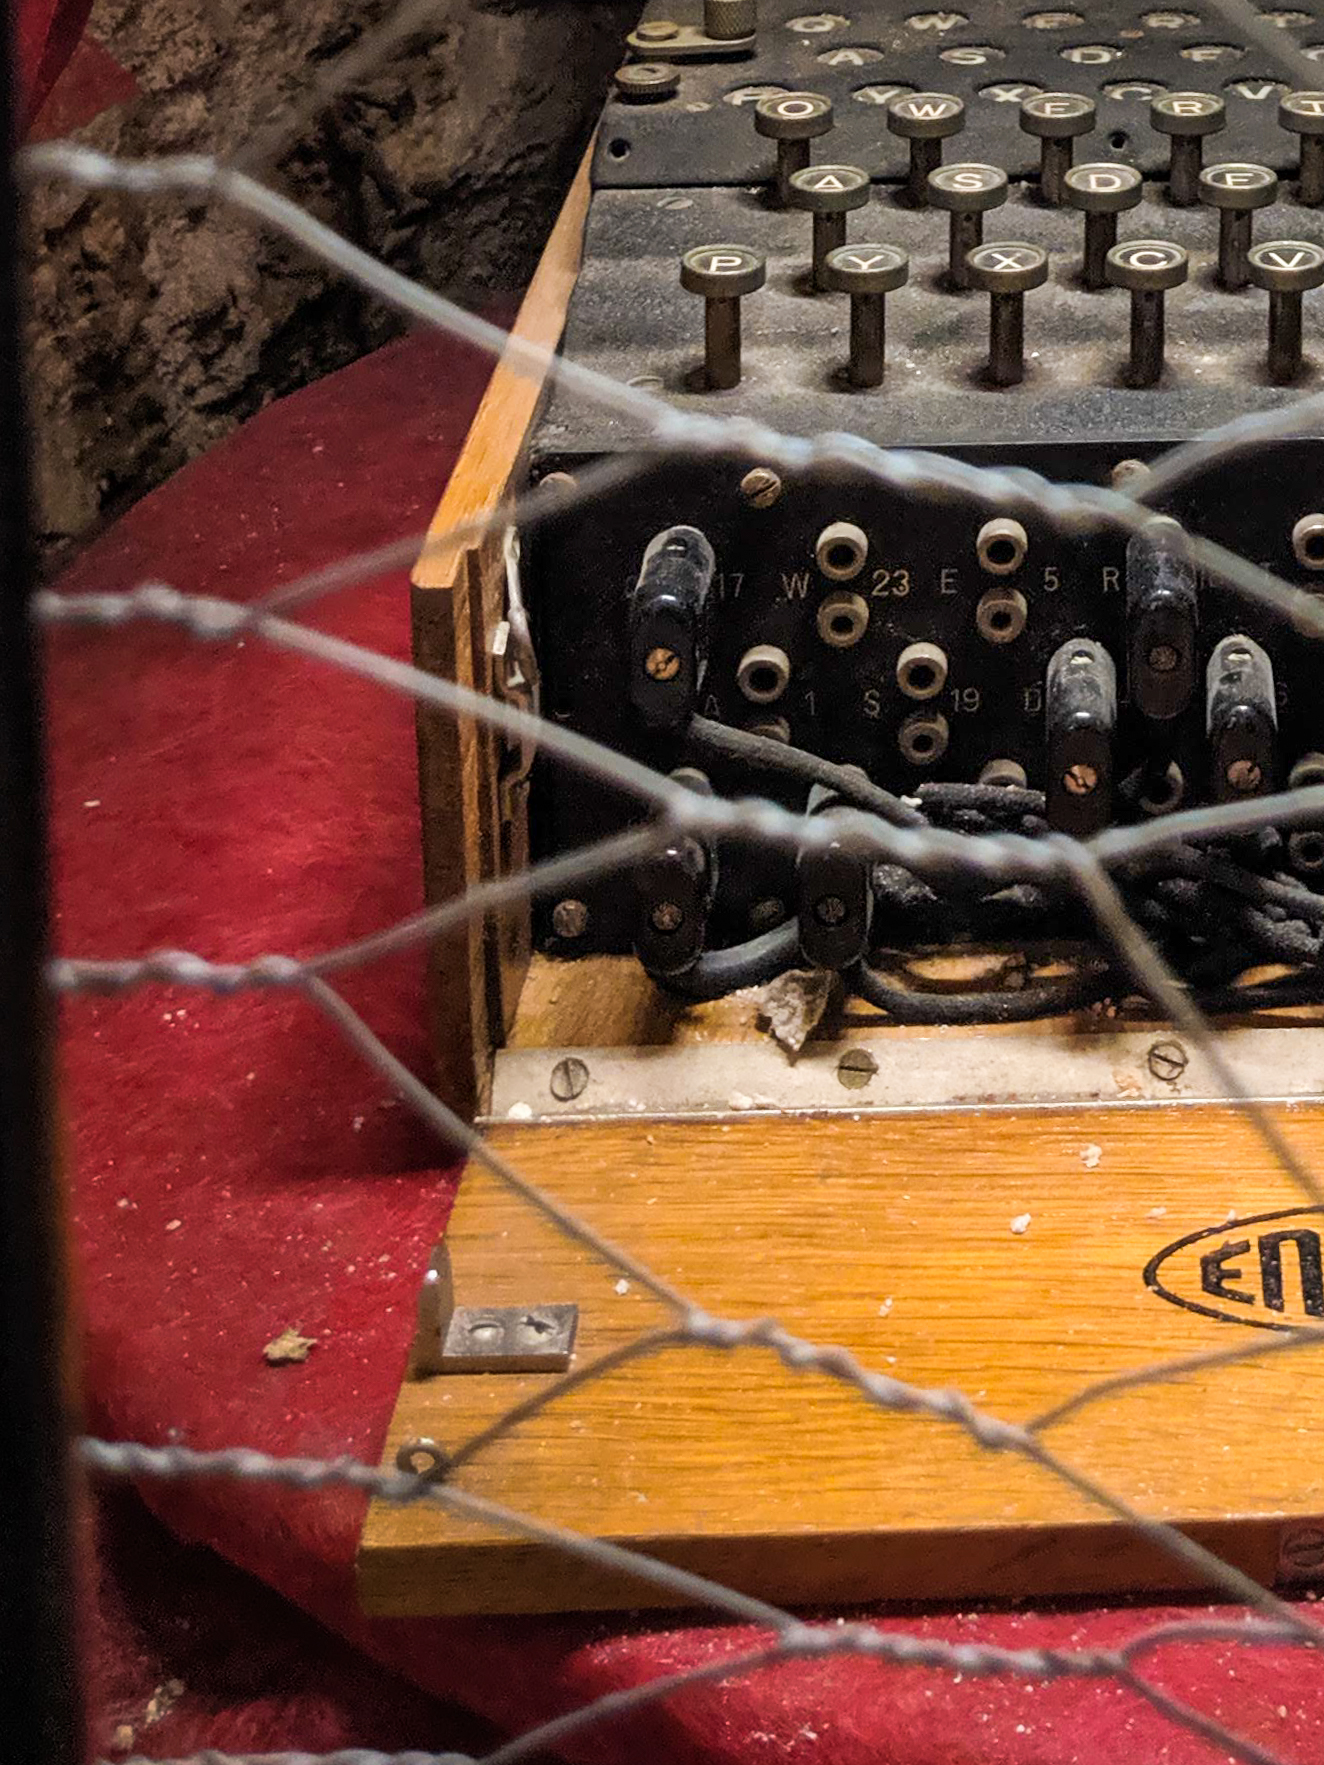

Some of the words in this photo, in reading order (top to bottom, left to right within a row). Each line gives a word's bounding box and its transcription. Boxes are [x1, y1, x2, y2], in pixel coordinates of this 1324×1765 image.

[828, 48, 864, 66] A
[949, 47, 987, 65] S
[1071, 46, 1112, 64] D
[866, 88, 901, 104] Y
[990, 87, 1025, 103] X
[1236, 85, 1274, 100] V
[907, 102, 948, 118] W
[1172, 101, 1203, 116] R
[813, 174, 845, 189] A
[952, 172, 984, 189] S
[1088, 173, 1122, 189] D
[709, 255, 744, 273] P
[849, 254, 885, 271] Y
[991, 252, 1024, 270] X
[1129, 250, 1168, 268] C
[1268, 251, 1306, 269] V
[782, 573, 810, 598] W
[872, 569, 911, 596] 23
[940, 568, 959, 594] E
[1043, 567, 1060, 591] 5
[1103, 566, 1121, 591] R
[805, 691, 816, 716] 1
[862, 690, 882, 719] S
[950, 688, 980, 713] 19
